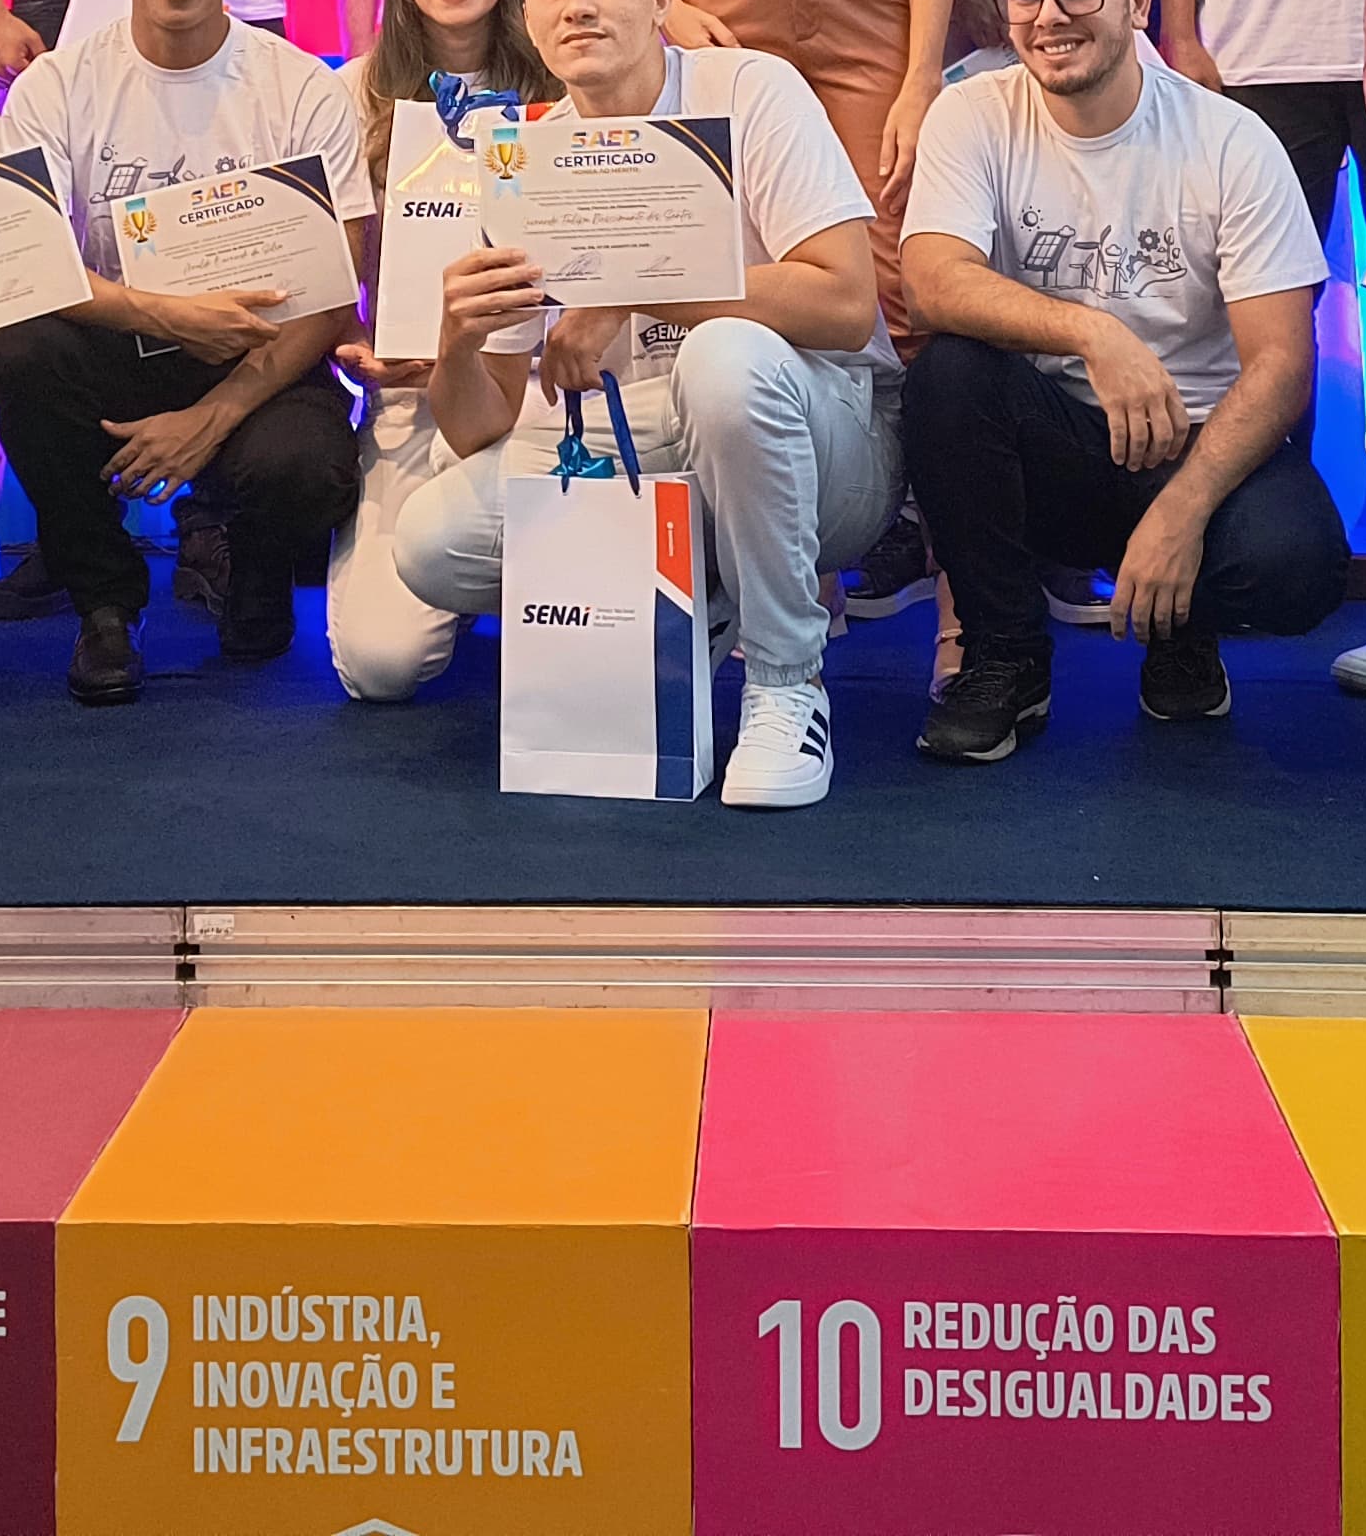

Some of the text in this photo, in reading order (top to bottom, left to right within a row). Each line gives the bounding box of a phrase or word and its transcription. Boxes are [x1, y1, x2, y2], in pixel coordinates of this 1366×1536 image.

[554, 152, 656, 168] CERTIFICADO
[571, 129, 639, 149] SAEP
[178, 196, 265, 225] CERTIFICADO
[190, 179, 248, 205] SAEP
[192, 1286, 441, 1348] INDÚSTRIA,
[903, 1295, 1217, 1360] REDUÇÃO DAS
[107, 1295, 170, 1442] 9
[192, 1353, 456, 1418] INOVAÇÃO E
[758, 1299, 882, 1451] 10
[903, 1369, 1273, 1423] DESIGUALDADES
[192, 1426, 583, 1477] INFRAESTRUTURA
